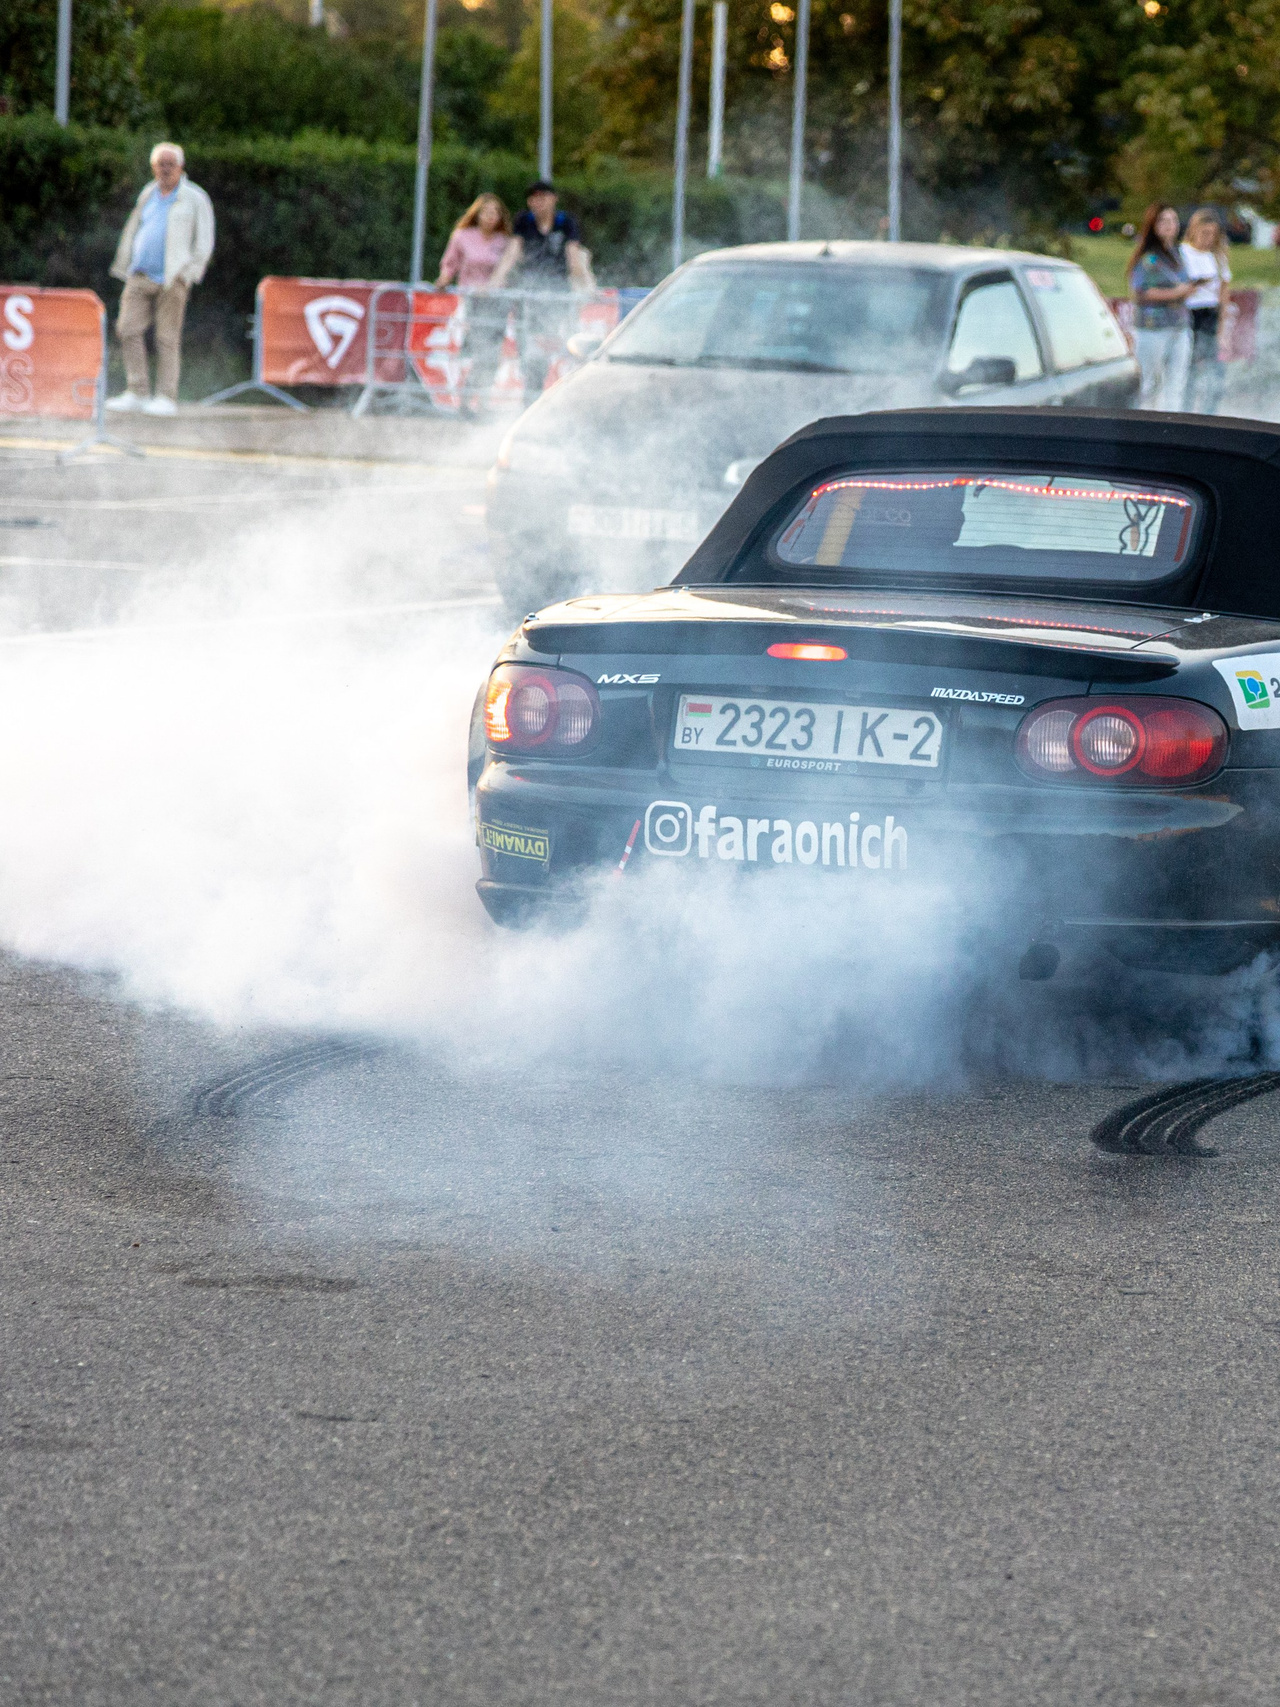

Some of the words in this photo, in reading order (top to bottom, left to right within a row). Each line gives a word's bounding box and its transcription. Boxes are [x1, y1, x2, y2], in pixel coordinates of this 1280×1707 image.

[597, 673, 661, 684] MX5
[930, 687, 1025, 706] MAZDASPEED
[715, 702, 816, 751] 2323
[681, 727, 704, 745] BY
[766, 758, 841, 772] EUROSPORT
[694, 805, 908, 870] faraonich
